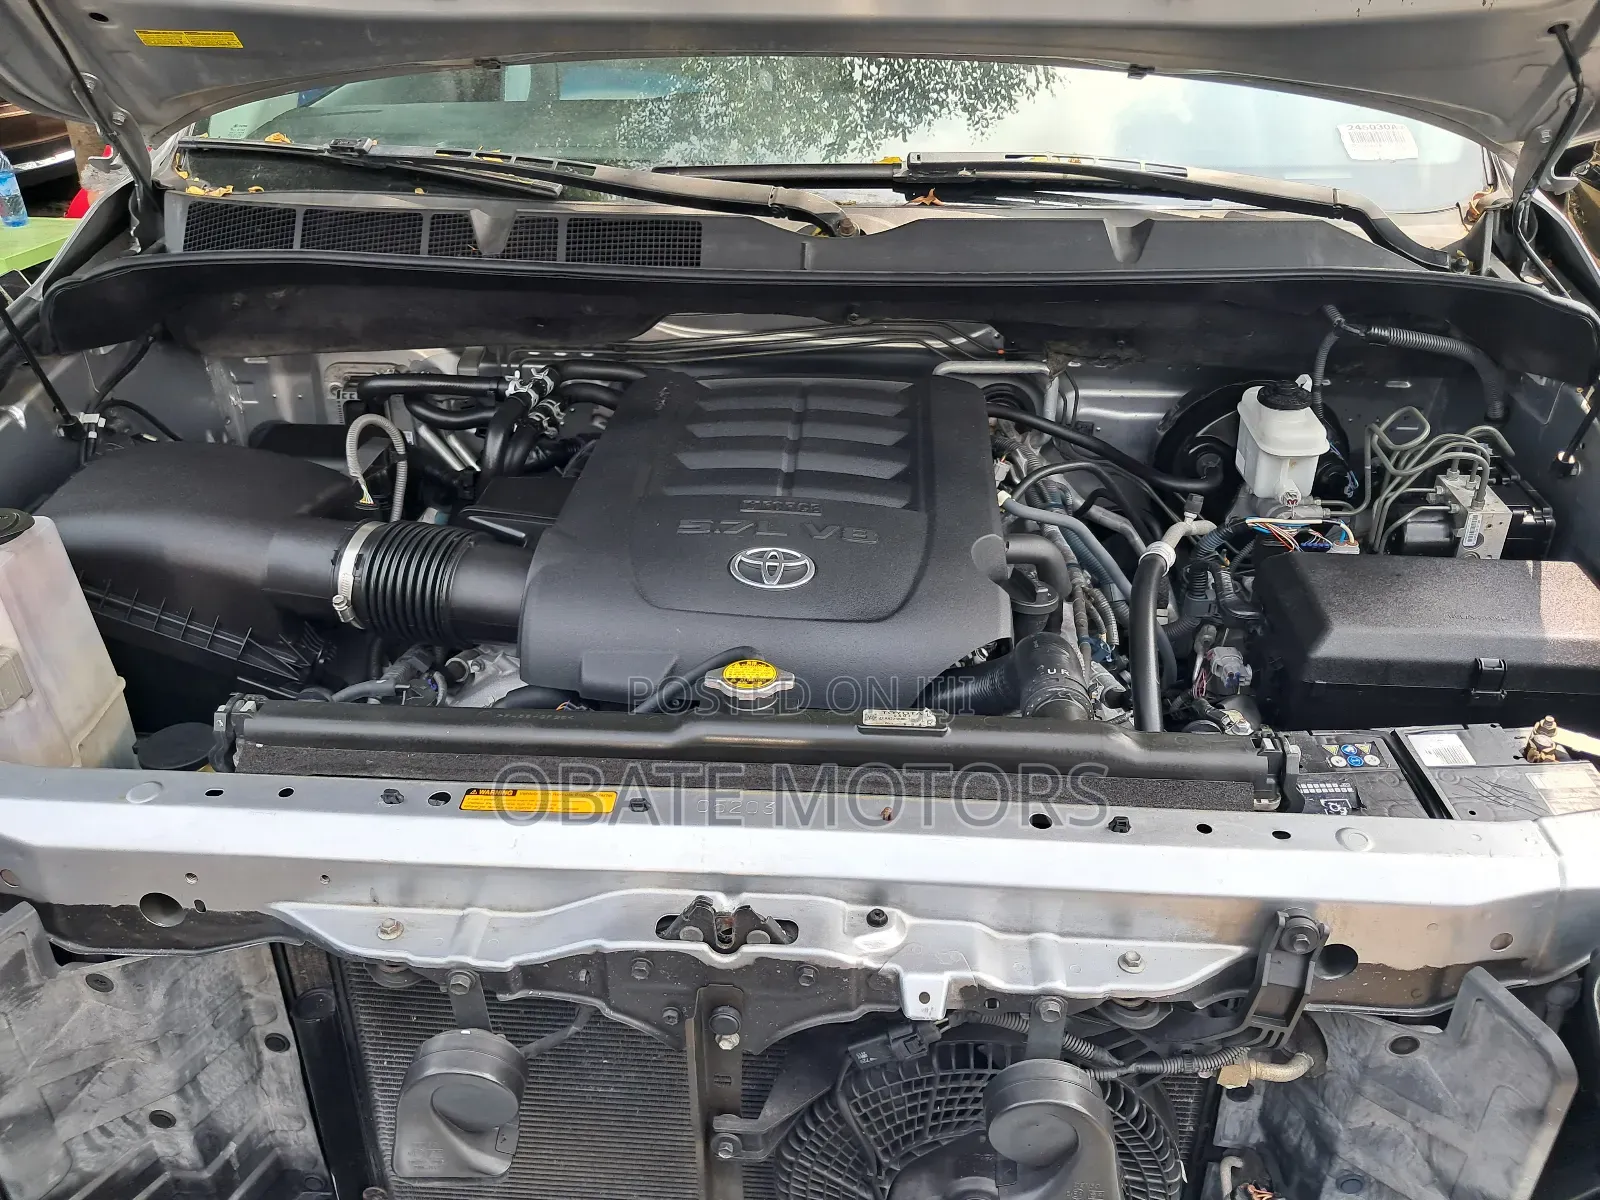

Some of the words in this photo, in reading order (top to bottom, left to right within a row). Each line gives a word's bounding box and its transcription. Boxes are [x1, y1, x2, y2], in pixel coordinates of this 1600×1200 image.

[1346, 123, 1405, 131] 245030A
[676, 518, 789, 538] 5.7L
[802, 521, 881, 546] V8
[696, 799, 776, 815] 05203
